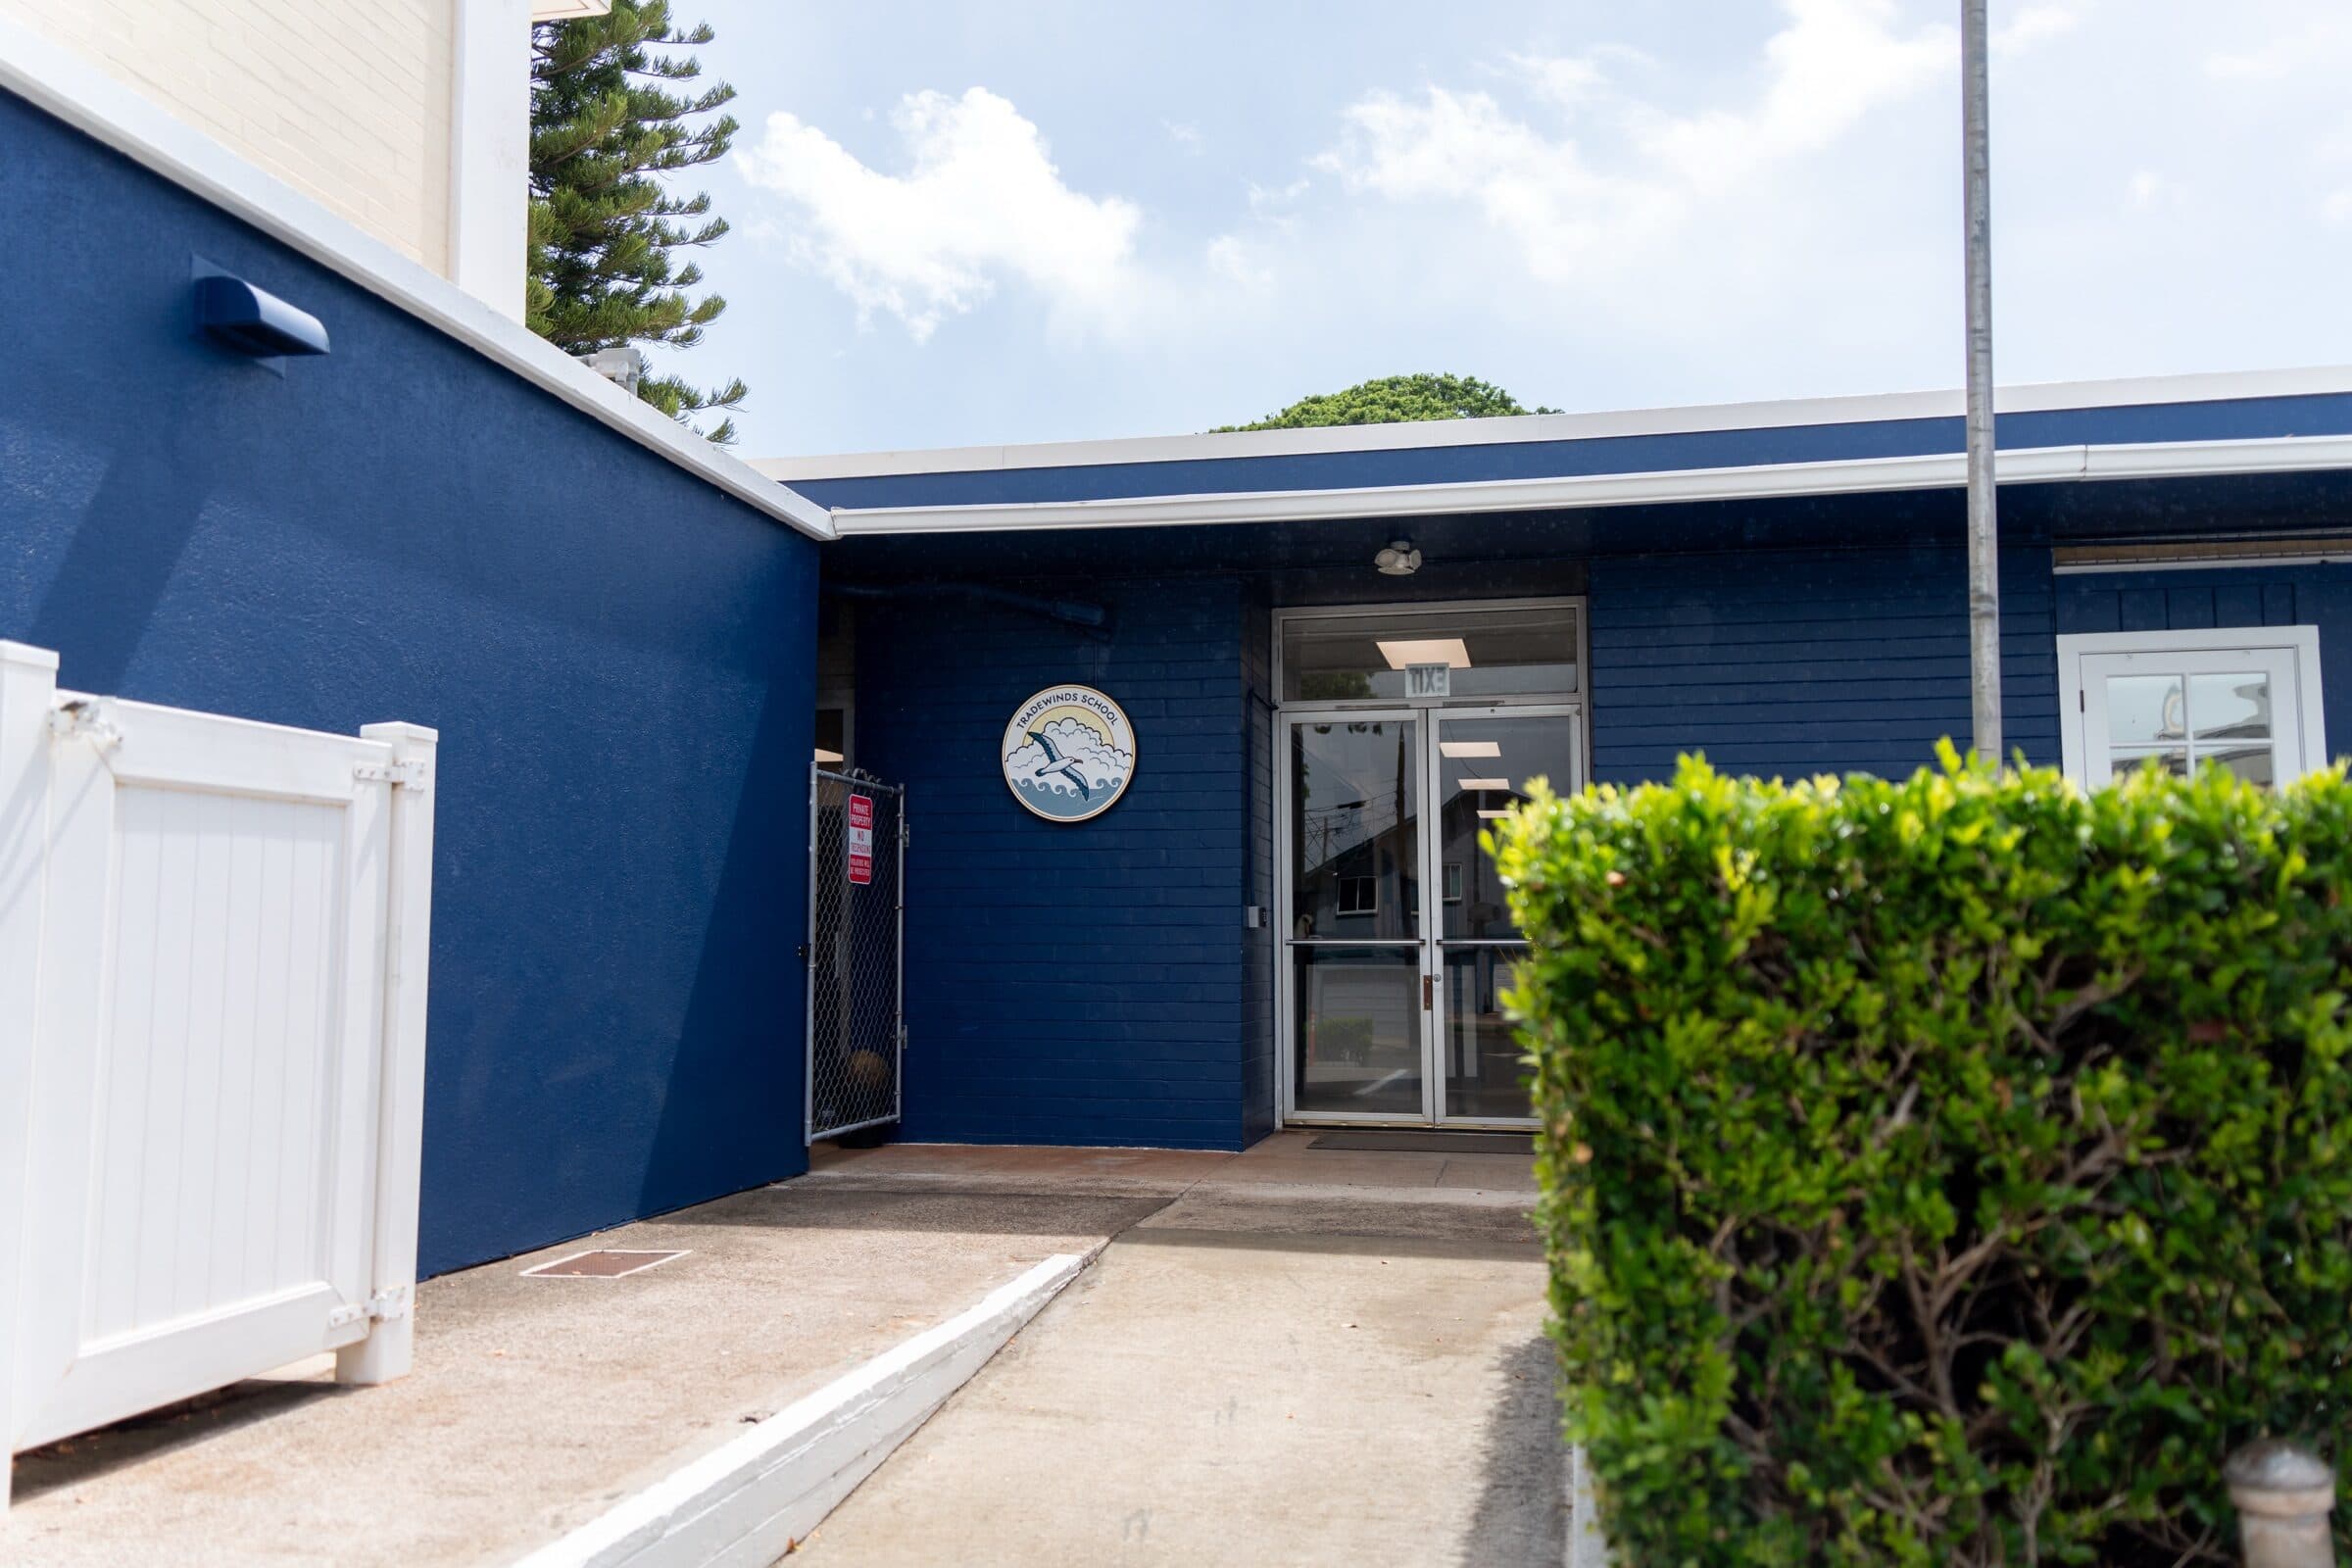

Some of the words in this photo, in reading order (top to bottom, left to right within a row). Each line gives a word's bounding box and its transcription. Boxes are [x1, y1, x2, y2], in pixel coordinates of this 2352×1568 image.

[1017, 693, 1078, 729] TRADEWINDS
[1081, 694, 1118, 726] SCHOOL
[851, 813, 870, 828] PROPERTY
